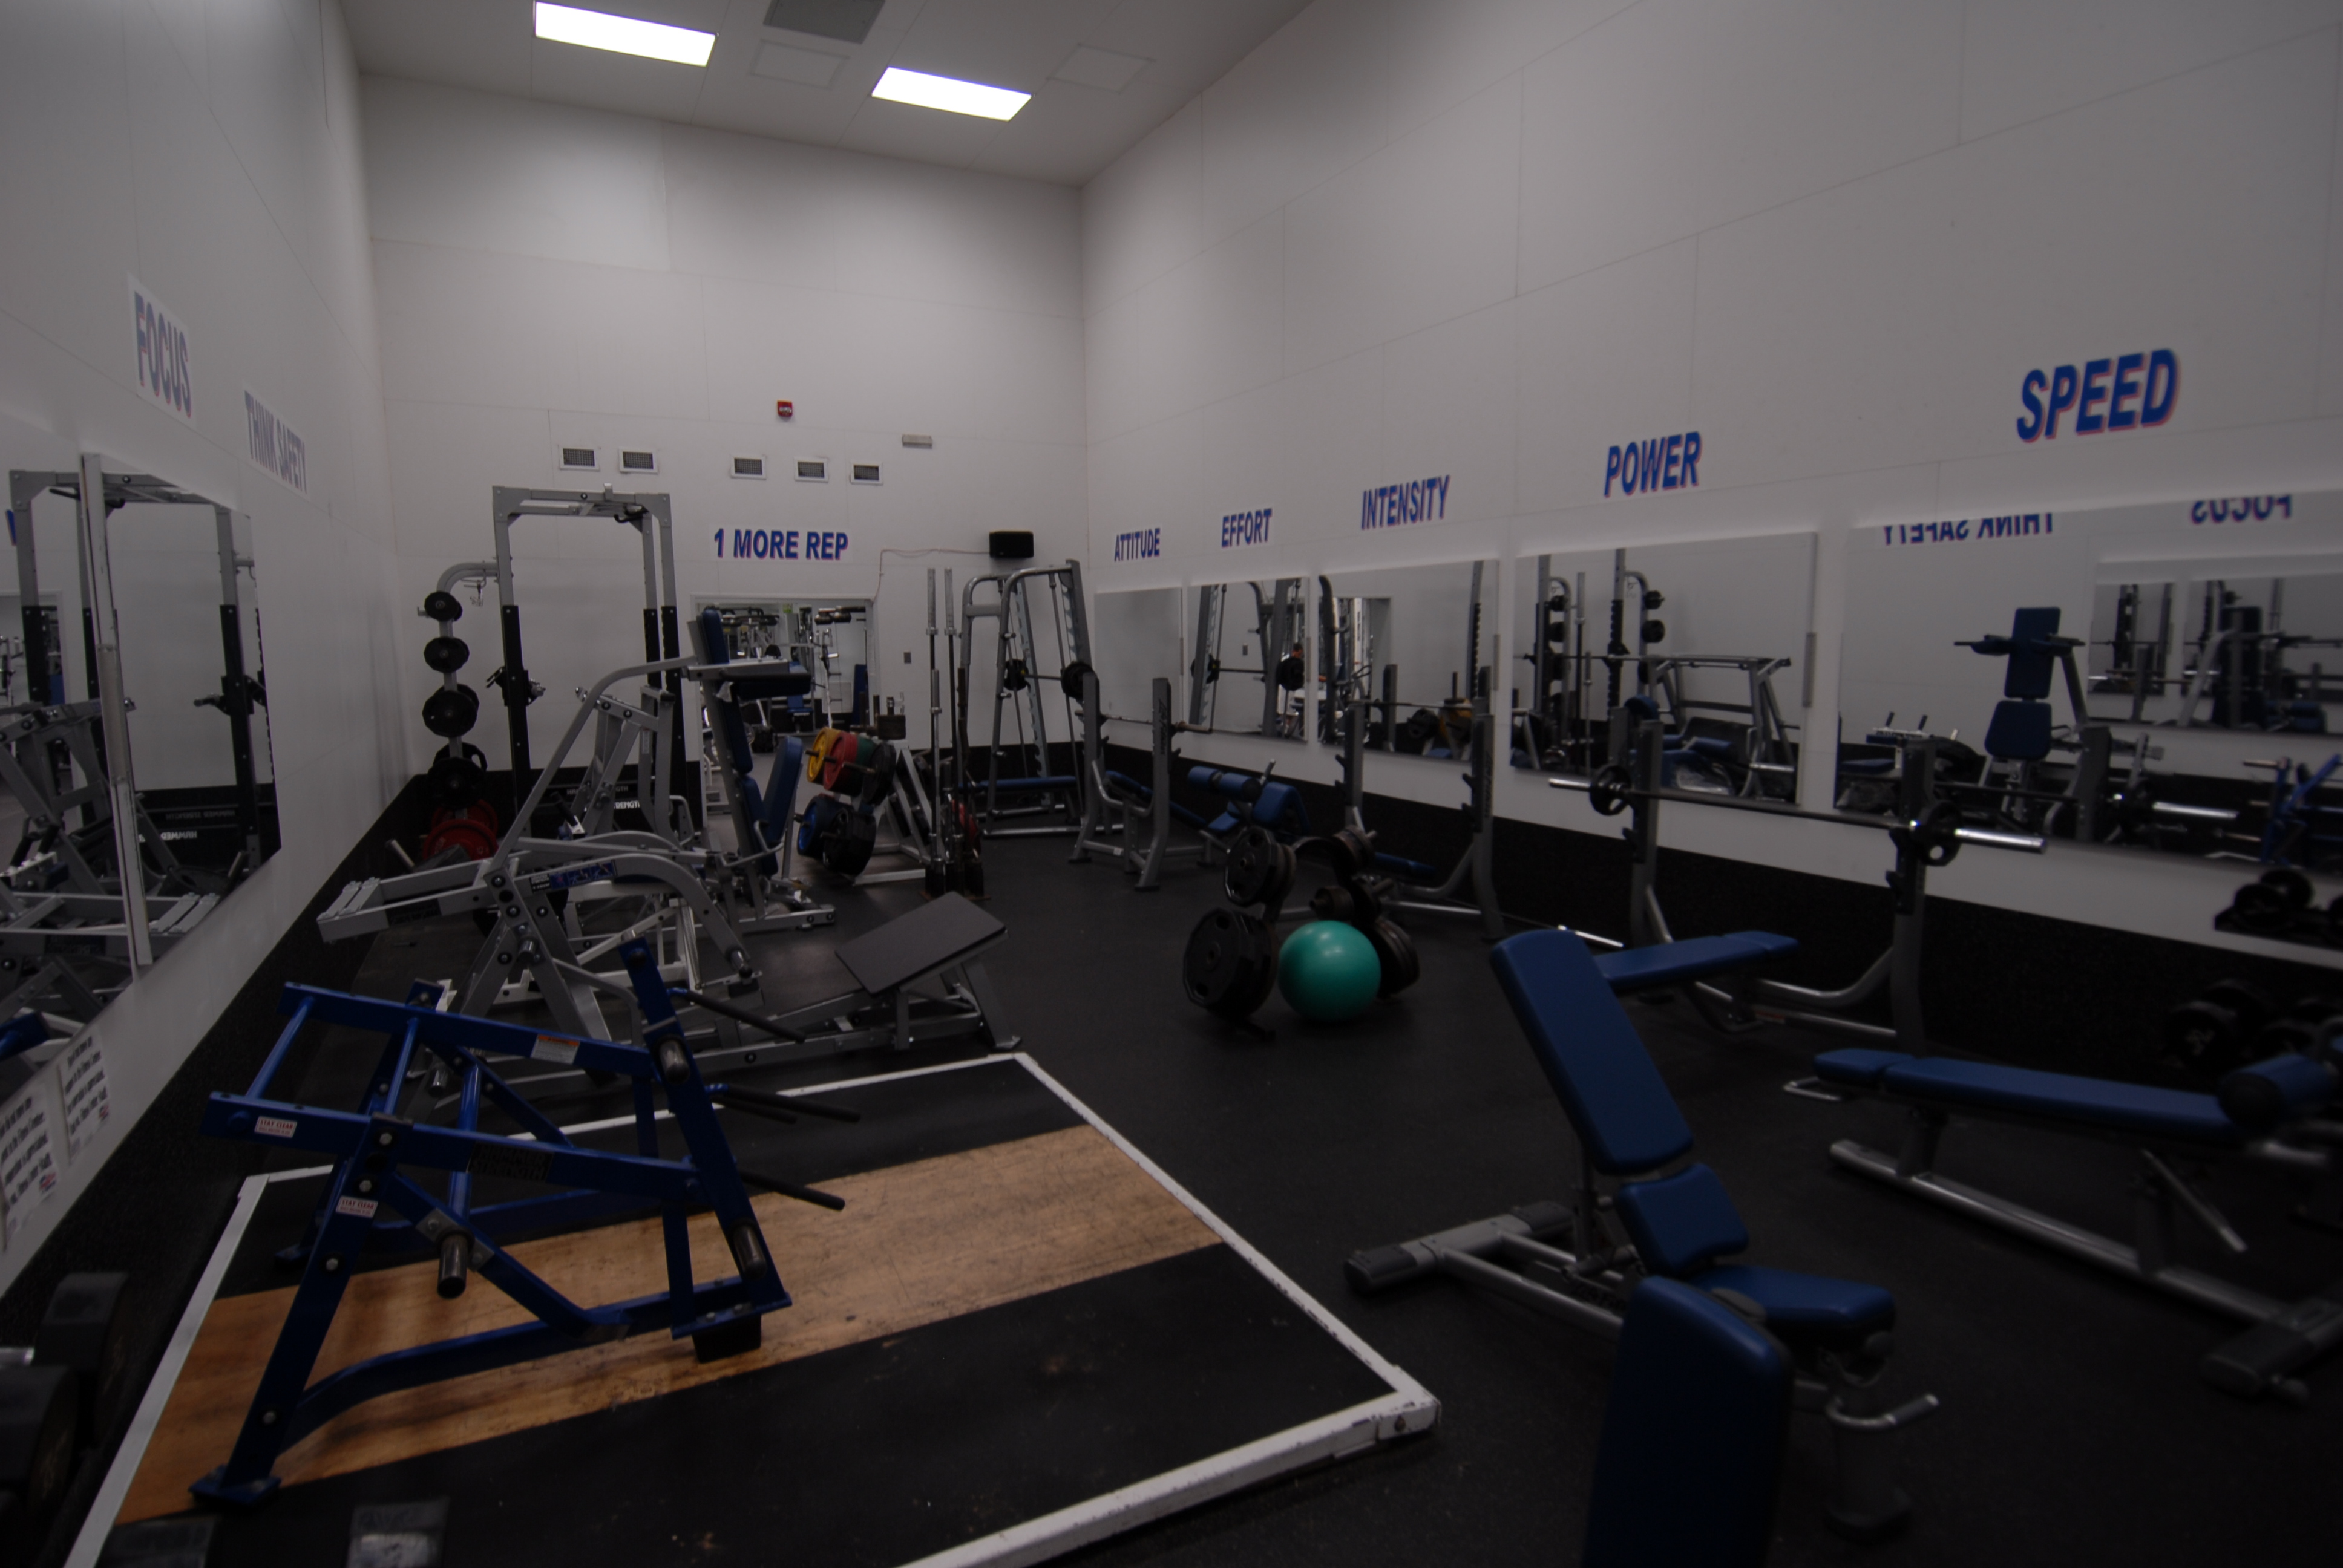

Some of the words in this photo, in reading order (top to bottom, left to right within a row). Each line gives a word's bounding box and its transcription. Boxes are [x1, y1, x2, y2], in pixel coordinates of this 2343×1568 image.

[134, 291, 192, 417] FOCUS
[2016, 348, 2181, 443] SPEED
[244, 390, 277, 474] THINK
[276, 419, 307, 494] SAFETY
[1604, 431, 1702, 497] POWER
[1361, 475, 1450, 530] INTENSITY
[714, 528, 725, 558] 1
[733, 529, 799, 560] MORE
[806, 532, 848, 560] REP
[1114, 528, 1161, 562] ATTITUDE
[1221, 508, 1273, 547] EFFORT
[260, 1119, 274, 1127] STAY
[342, 1198, 356, 1207] STAY
[358, 1201, 375, 1210] CLEAR
